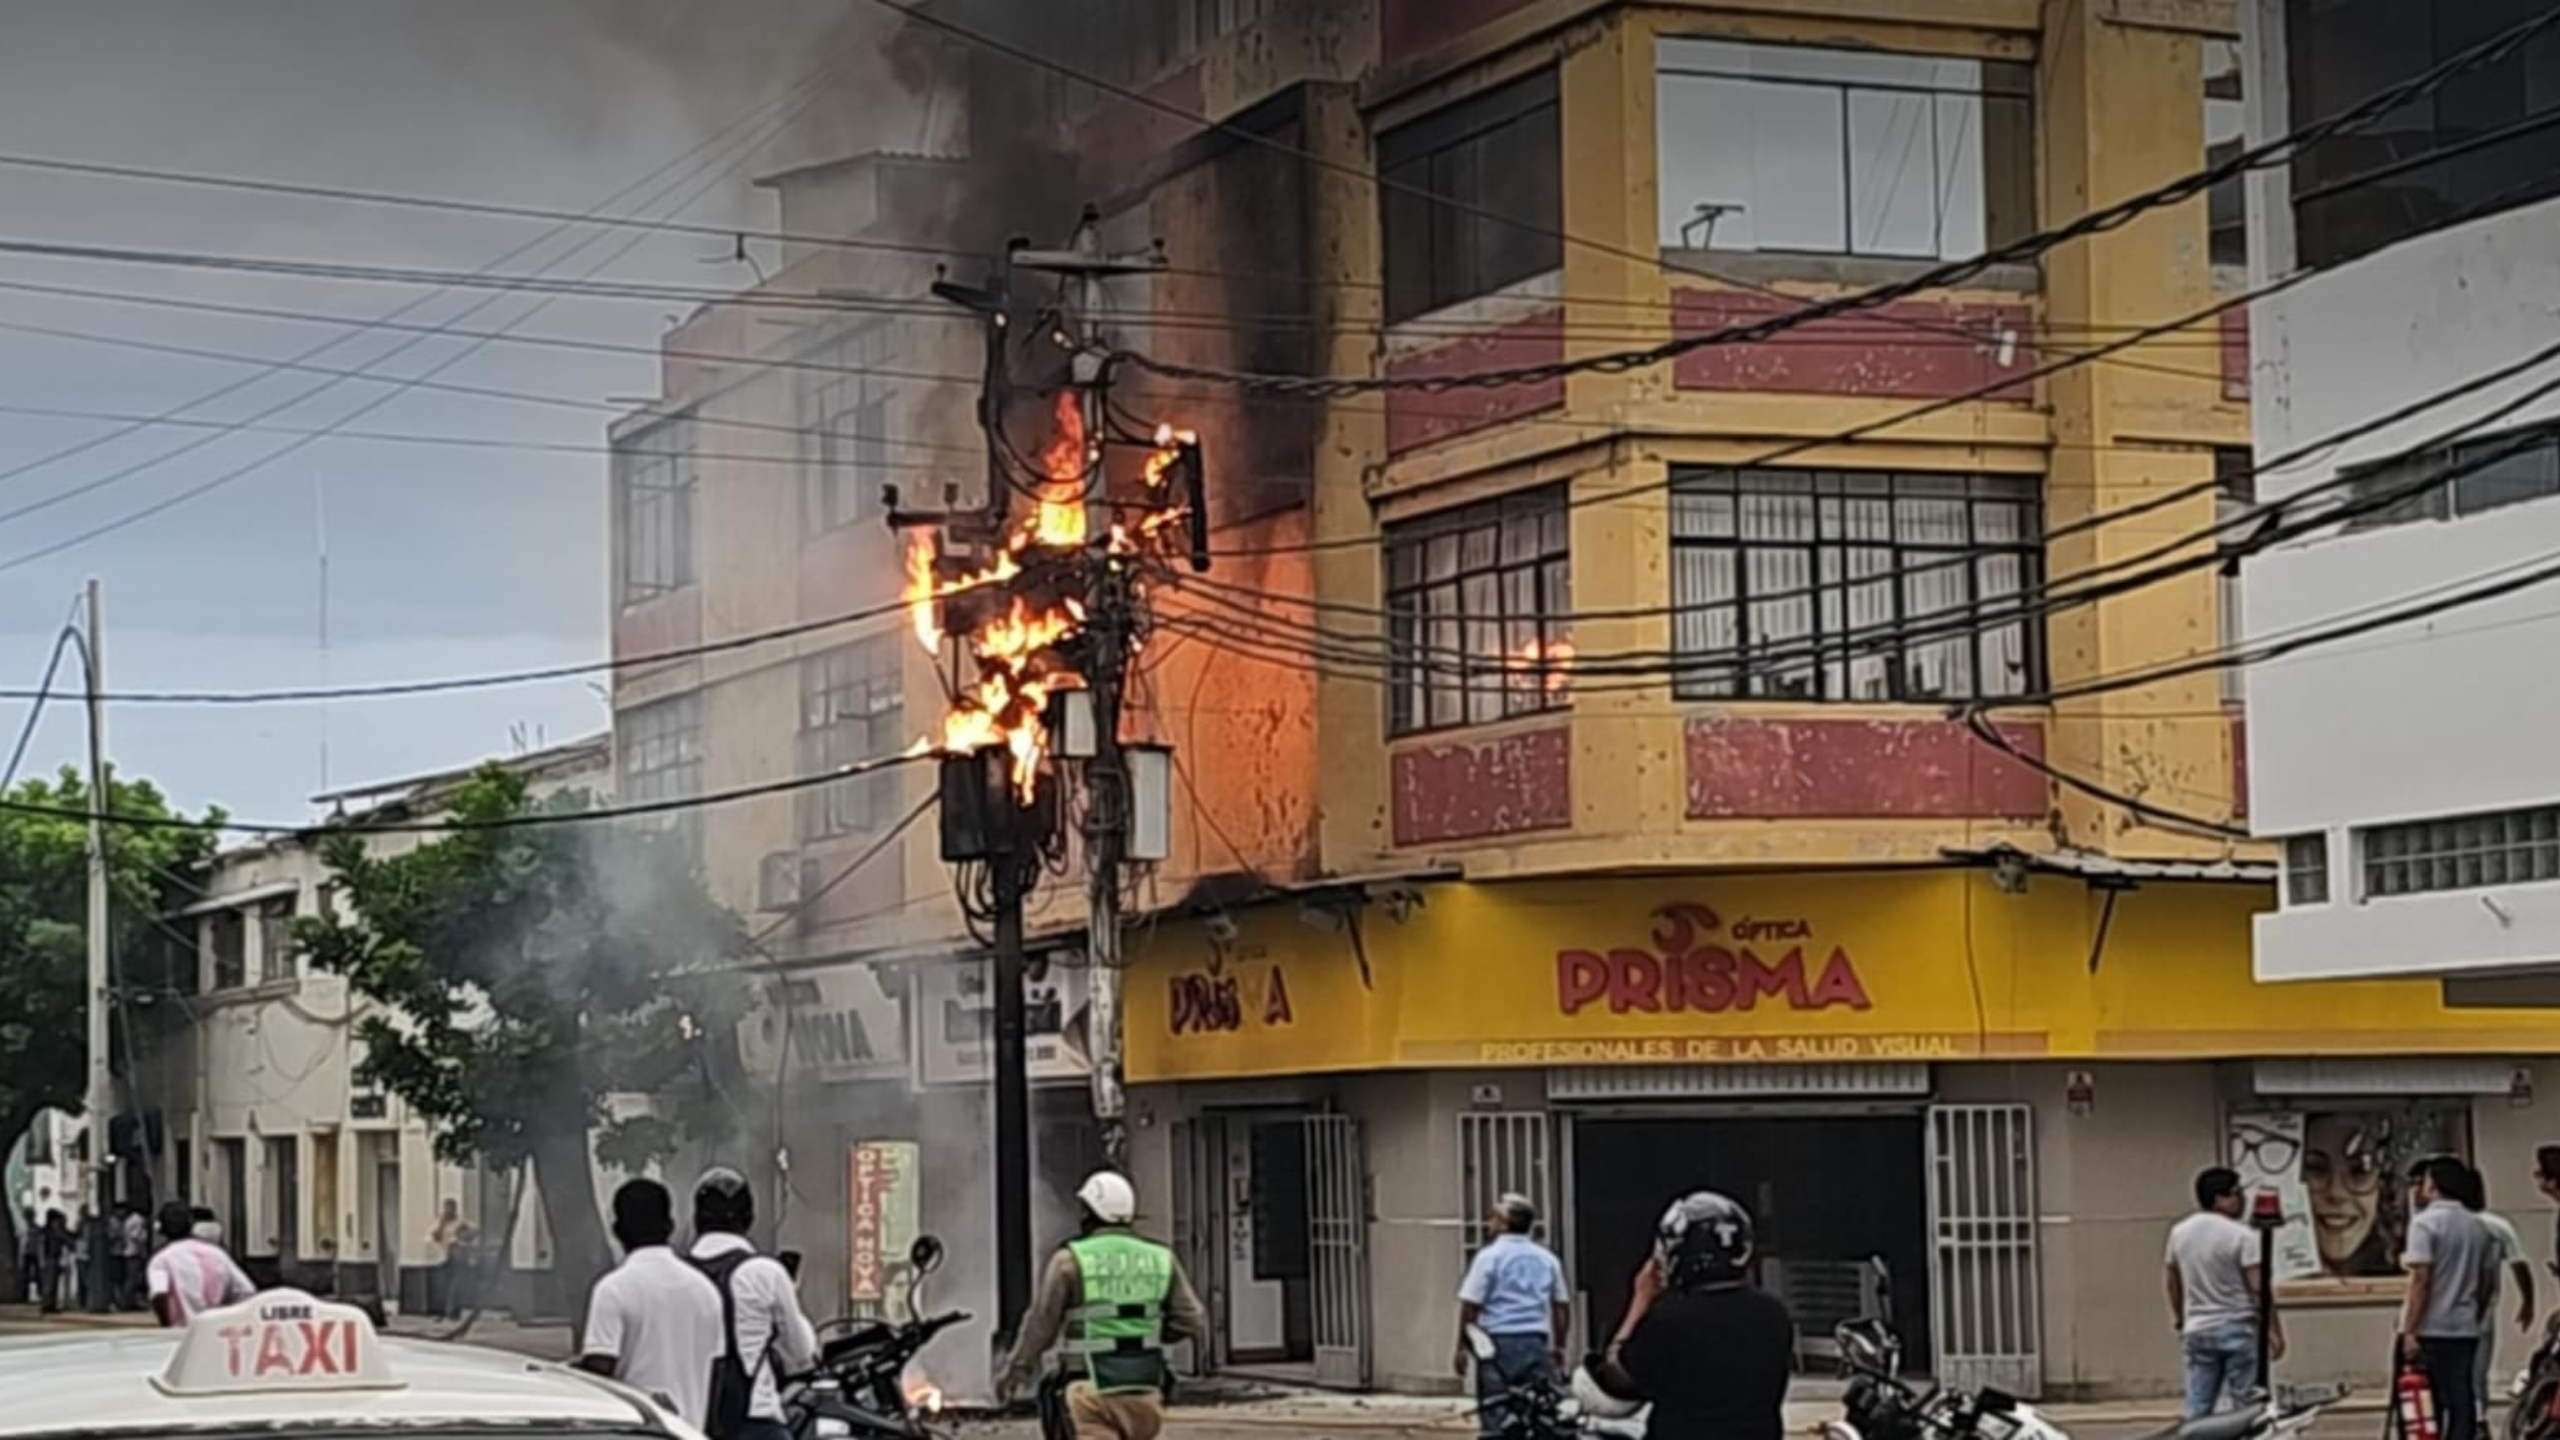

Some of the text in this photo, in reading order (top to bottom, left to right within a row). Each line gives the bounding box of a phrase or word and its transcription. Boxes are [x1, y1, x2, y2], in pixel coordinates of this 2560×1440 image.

[1480, 1034, 1958, 1062] PROFESIONALES DE LA SALUD VISUAL
[260, 1305, 314, 1321] LIBRE
[216, 1319, 357, 1377] TAXI
